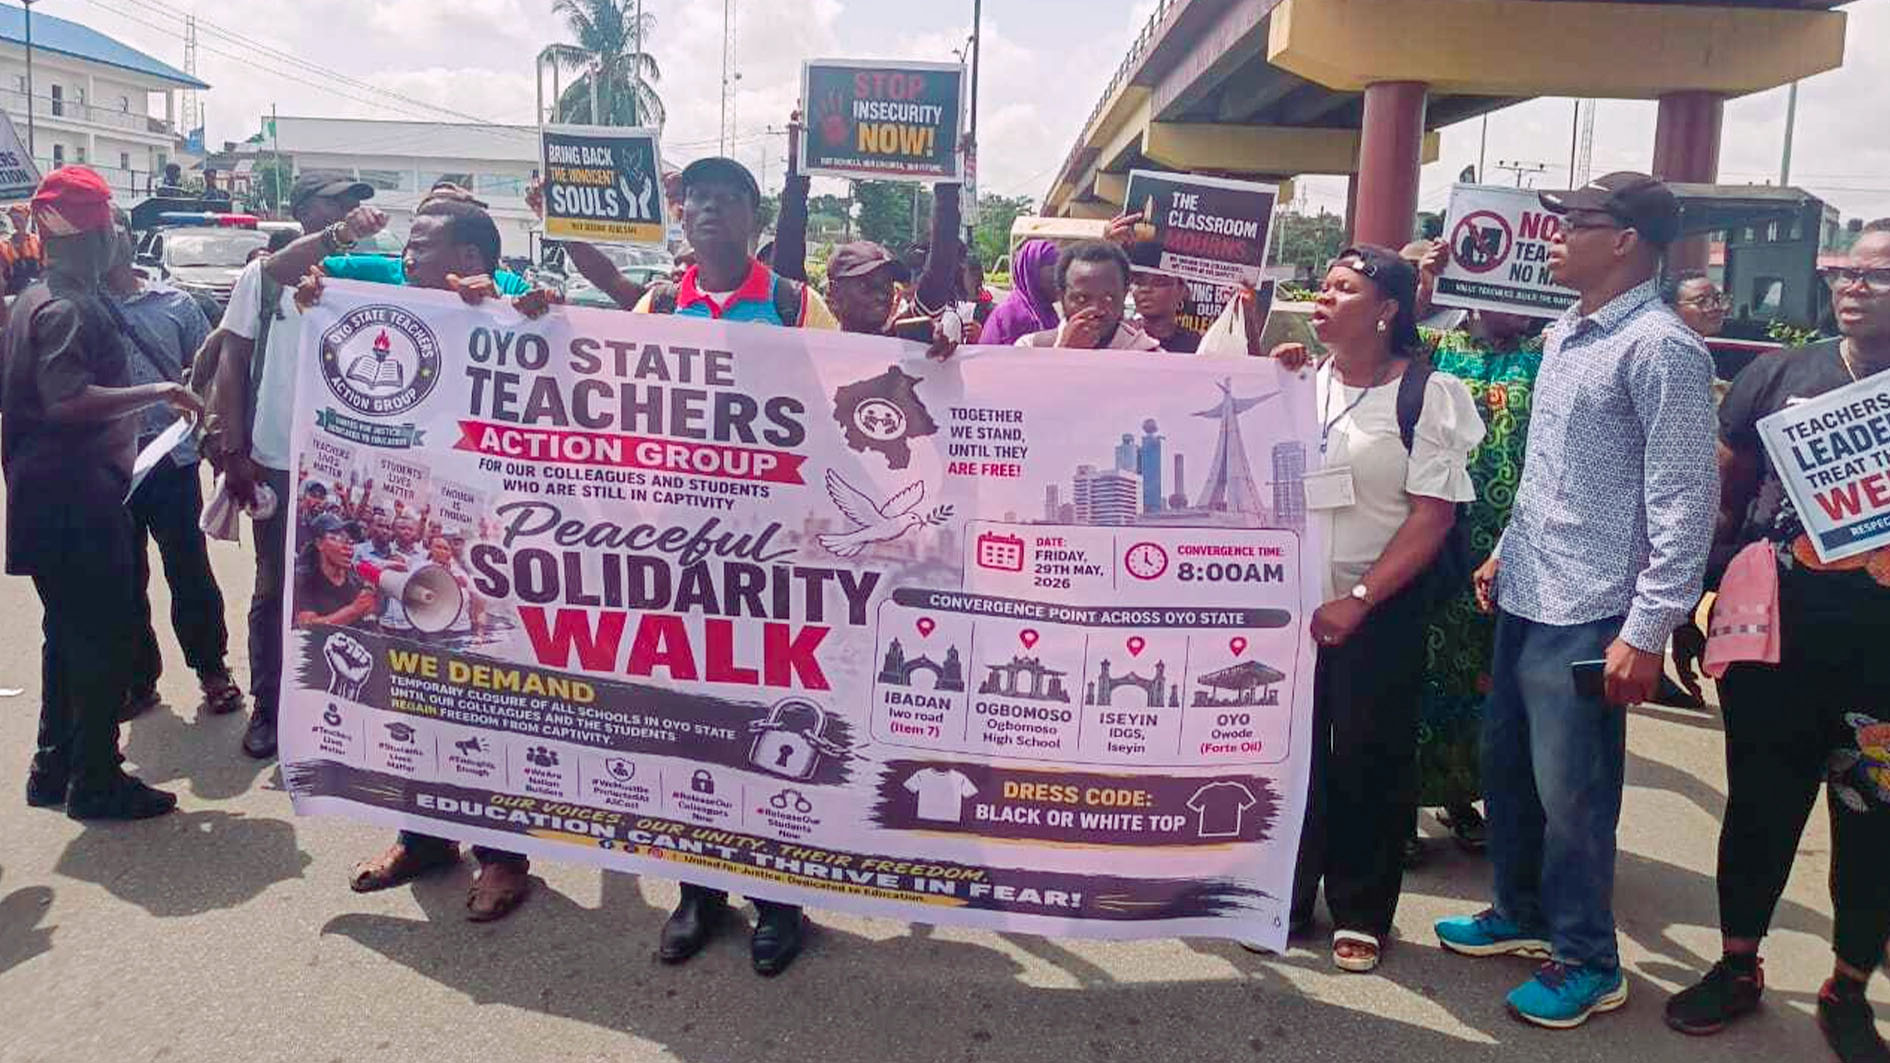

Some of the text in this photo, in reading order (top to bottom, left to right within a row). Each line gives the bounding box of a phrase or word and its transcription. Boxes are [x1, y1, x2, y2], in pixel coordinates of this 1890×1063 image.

[855, 72, 924, 99] STOP
[853, 101, 943, 125] INSECURITY
[858, 122, 935, 158] NOW!
[549, 143, 614, 166] BRING BACK
[551, 184, 619, 217] SOULS
[1172, 191, 1200, 211] THE
[1168, 211, 1258, 239] CLASSROOM
[1508, 263, 1533, 283] NO
[329, 308, 434, 359] OYO STATE TEACHERS
[467, 325, 736, 387] OYO STATE
[330, 376, 417, 411] ACTION GROUP
[464, 365, 806, 448] TEACHERS
[949, 407, 1024, 424] TOGETHER
[1782, 392, 1890, 443] TEACHERS
[950, 426, 1026, 444] WE STAND,
[1791, 414, 1890, 473] LEADE
[479, 425, 779, 478] ACTION GROUP
[949, 443, 1028, 461] UNTIL THEY
[478, 457, 770, 498] FOR OUR COLLEAGUES AND STUDENTS
[948, 461, 1022, 478] ARE FREE!
[1806, 457, 1867, 489] TREAT
[502, 478, 736, 512] WHO ARE STILL IN CAPTIVITY
[1813, 470, 1890, 522] WE
[497, 500, 799, 567] Peaceful
[1036, 537, 1068, 547] DATE:
[1035, 549, 1087, 564] FRIDAY,
[1177, 545, 1284, 557] CONVERGENCE TIME:
[1035, 563, 1104, 577] 29TH MAY,
[1177, 562, 1285, 583] 8:00AM
[470, 543, 881, 626] SOLIDARITY
[1034, 577, 1071, 589] 2026
[929, 594, 1245, 625] CONVERGENCE POINT ACROSS OYO STATE
[516, 606, 832, 691] WALK
[388, 649, 595, 702] WE DEMAND
[390, 674, 736, 740] TEMPORARY CLOSURE OF ALL SCHOOLS IN OYO STATE
[884, 691, 951, 710] IBADAN
[976, 702, 1072, 723] OGBOMOSO
[390, 687, 676, 742] UNTIL OUR COLLEAGUES AND THE STUDENTS
[391, 698, 615, 746] REGAIN FREEDOM FROM CAPTIVITY.
[889, 707, 944, 723] Iwo road
[987, 718, 1057, 735] Ogbomoso
[1099, 712, 1158, 727] ISEYIN
[1217, 713, 1250, 726] OYO
[928, 725, 940, 738] 7)
[983, 732, 1061, 749] High School
[1109, 728, 1145, 741] IDGS,
[1211, 729, 1253, 740] Owode
[1107, 742, 1145, 755] Iseyin
[1241, 742, 1262, 754] Oil)
[1004, 781, 1153, 807] DRESS CODE:
[976, 803, 1187, 832] BLACK OR WHITE TOP
[490, 794, 989, 884] OUR VOICES. OUR UNITY. THEIR FREEDOM.
[417, 794, 1082, 910] EDUCATION CAN'T THRIVE IN FEAR!
[684, 854, 721, 868] United
